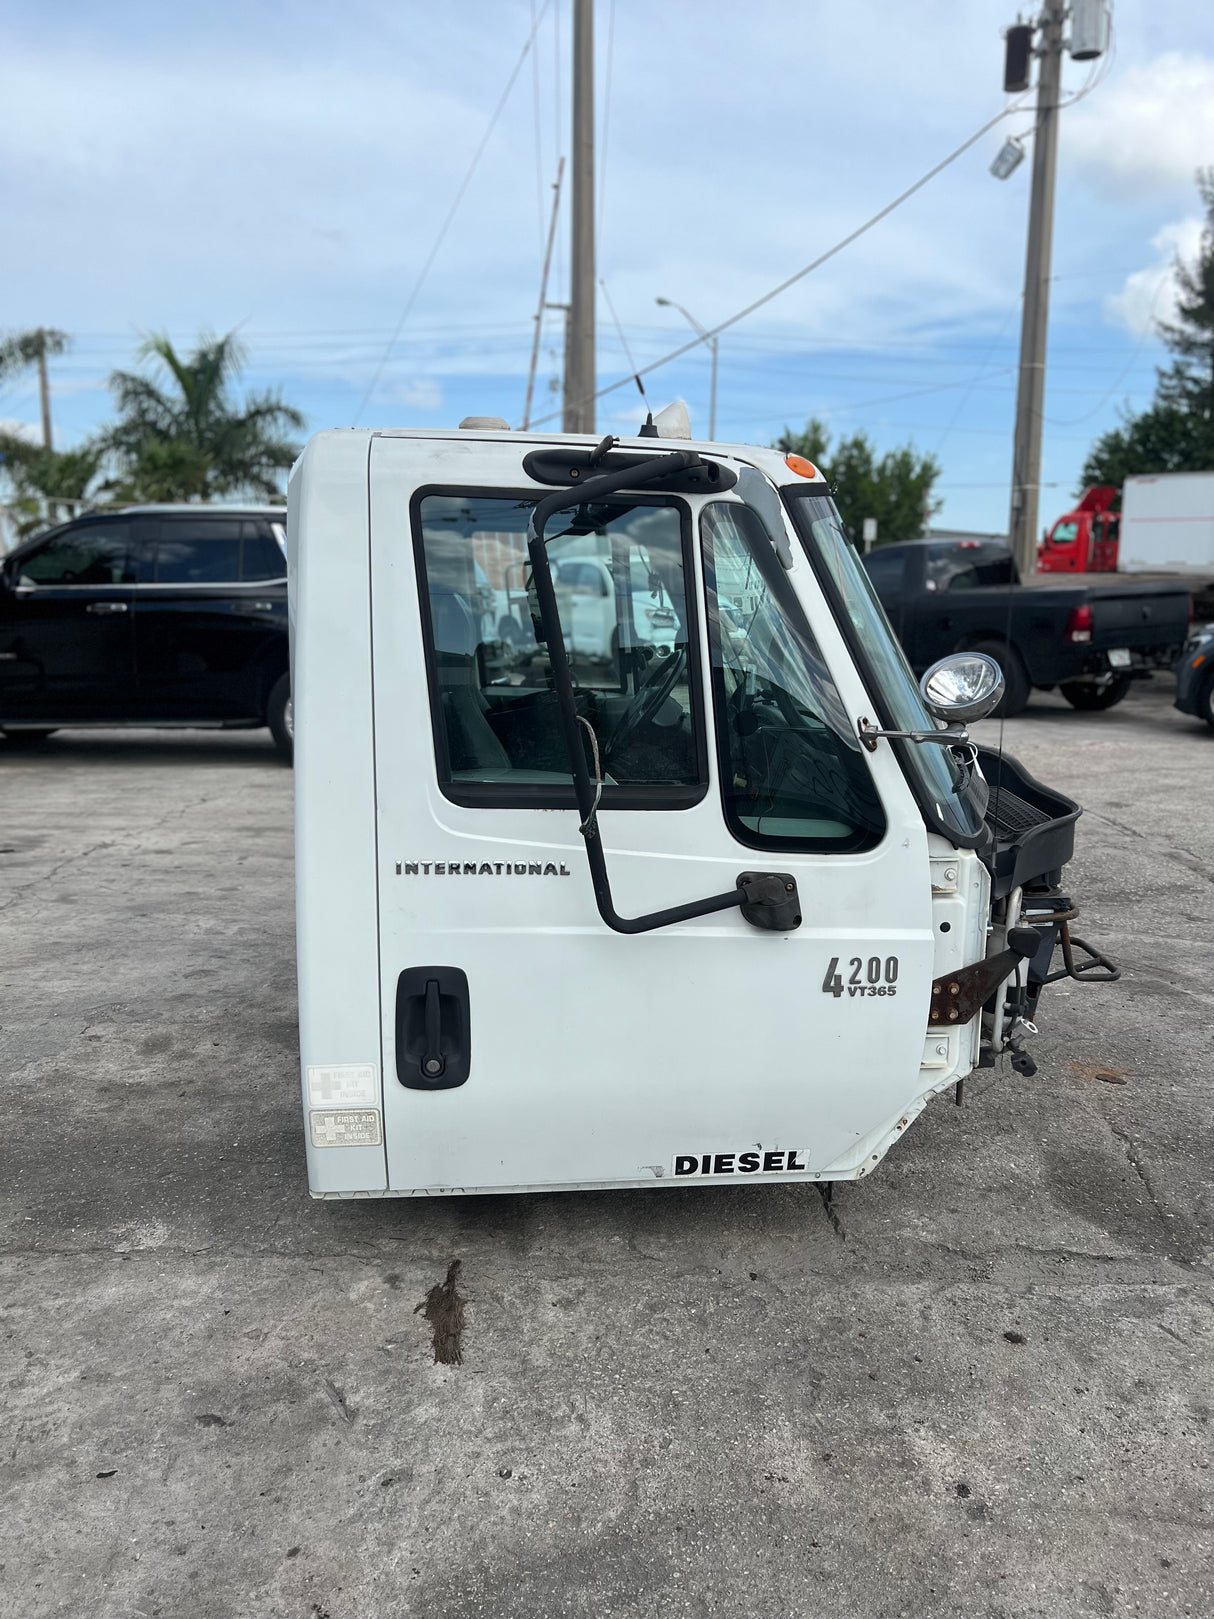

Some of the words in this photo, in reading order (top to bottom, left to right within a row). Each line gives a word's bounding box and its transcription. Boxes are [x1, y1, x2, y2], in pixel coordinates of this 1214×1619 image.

[395, 860, 571, 876] INTERNATIONAL
[822, 956, 899, 998] 4200
[847, 985, 897, 997] VT365
[337, 1115, 358, 1123] FIRST
[344, 1132, 370, 1140] INSIDE
[674, 1150, 806, 1176] DIESEL
